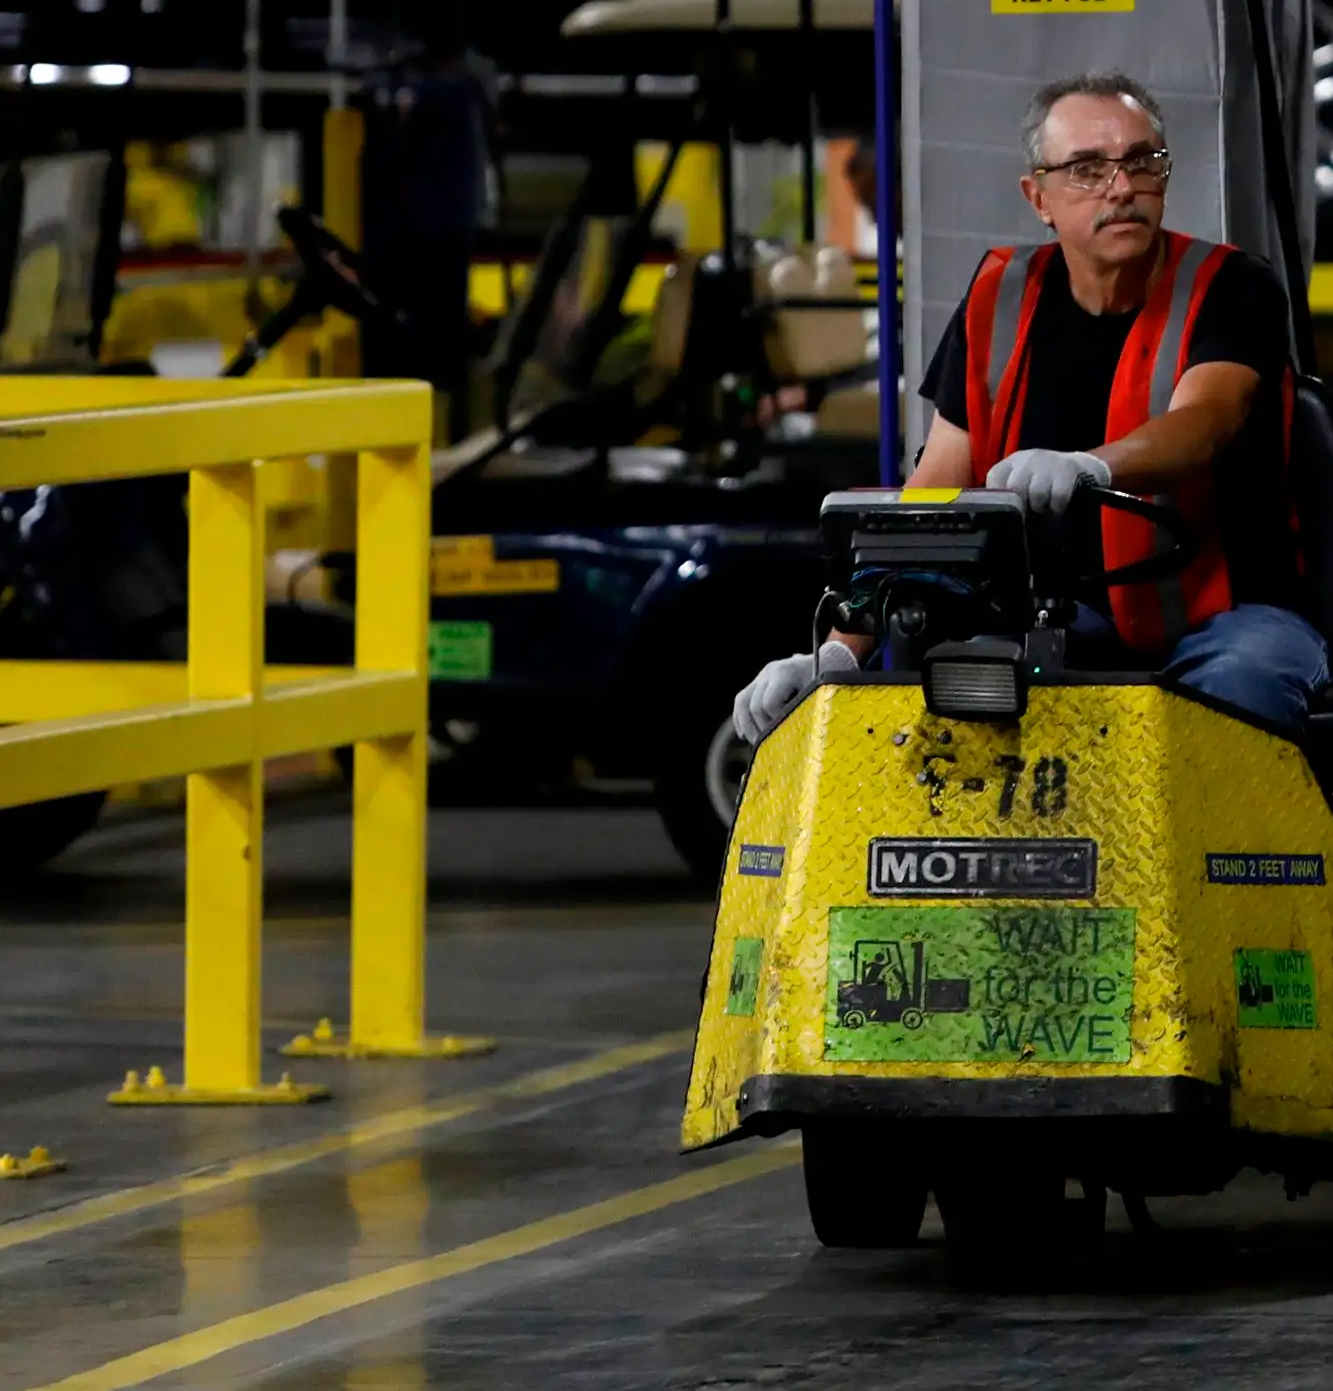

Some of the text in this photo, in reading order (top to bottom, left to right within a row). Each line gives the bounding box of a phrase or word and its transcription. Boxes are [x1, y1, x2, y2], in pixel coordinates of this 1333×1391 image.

[880, 851, 1083, 884] MOTREC
[1211, 859, 1319, 877] STAND 2 FEET AWAY
[981, 915, 1112, 955] WAIT
[984, 966, 1117, 1006] for the
[1277, 1003, 1313, 1024] WAVE
[982, 1014, 1114, 1053] WAVE
